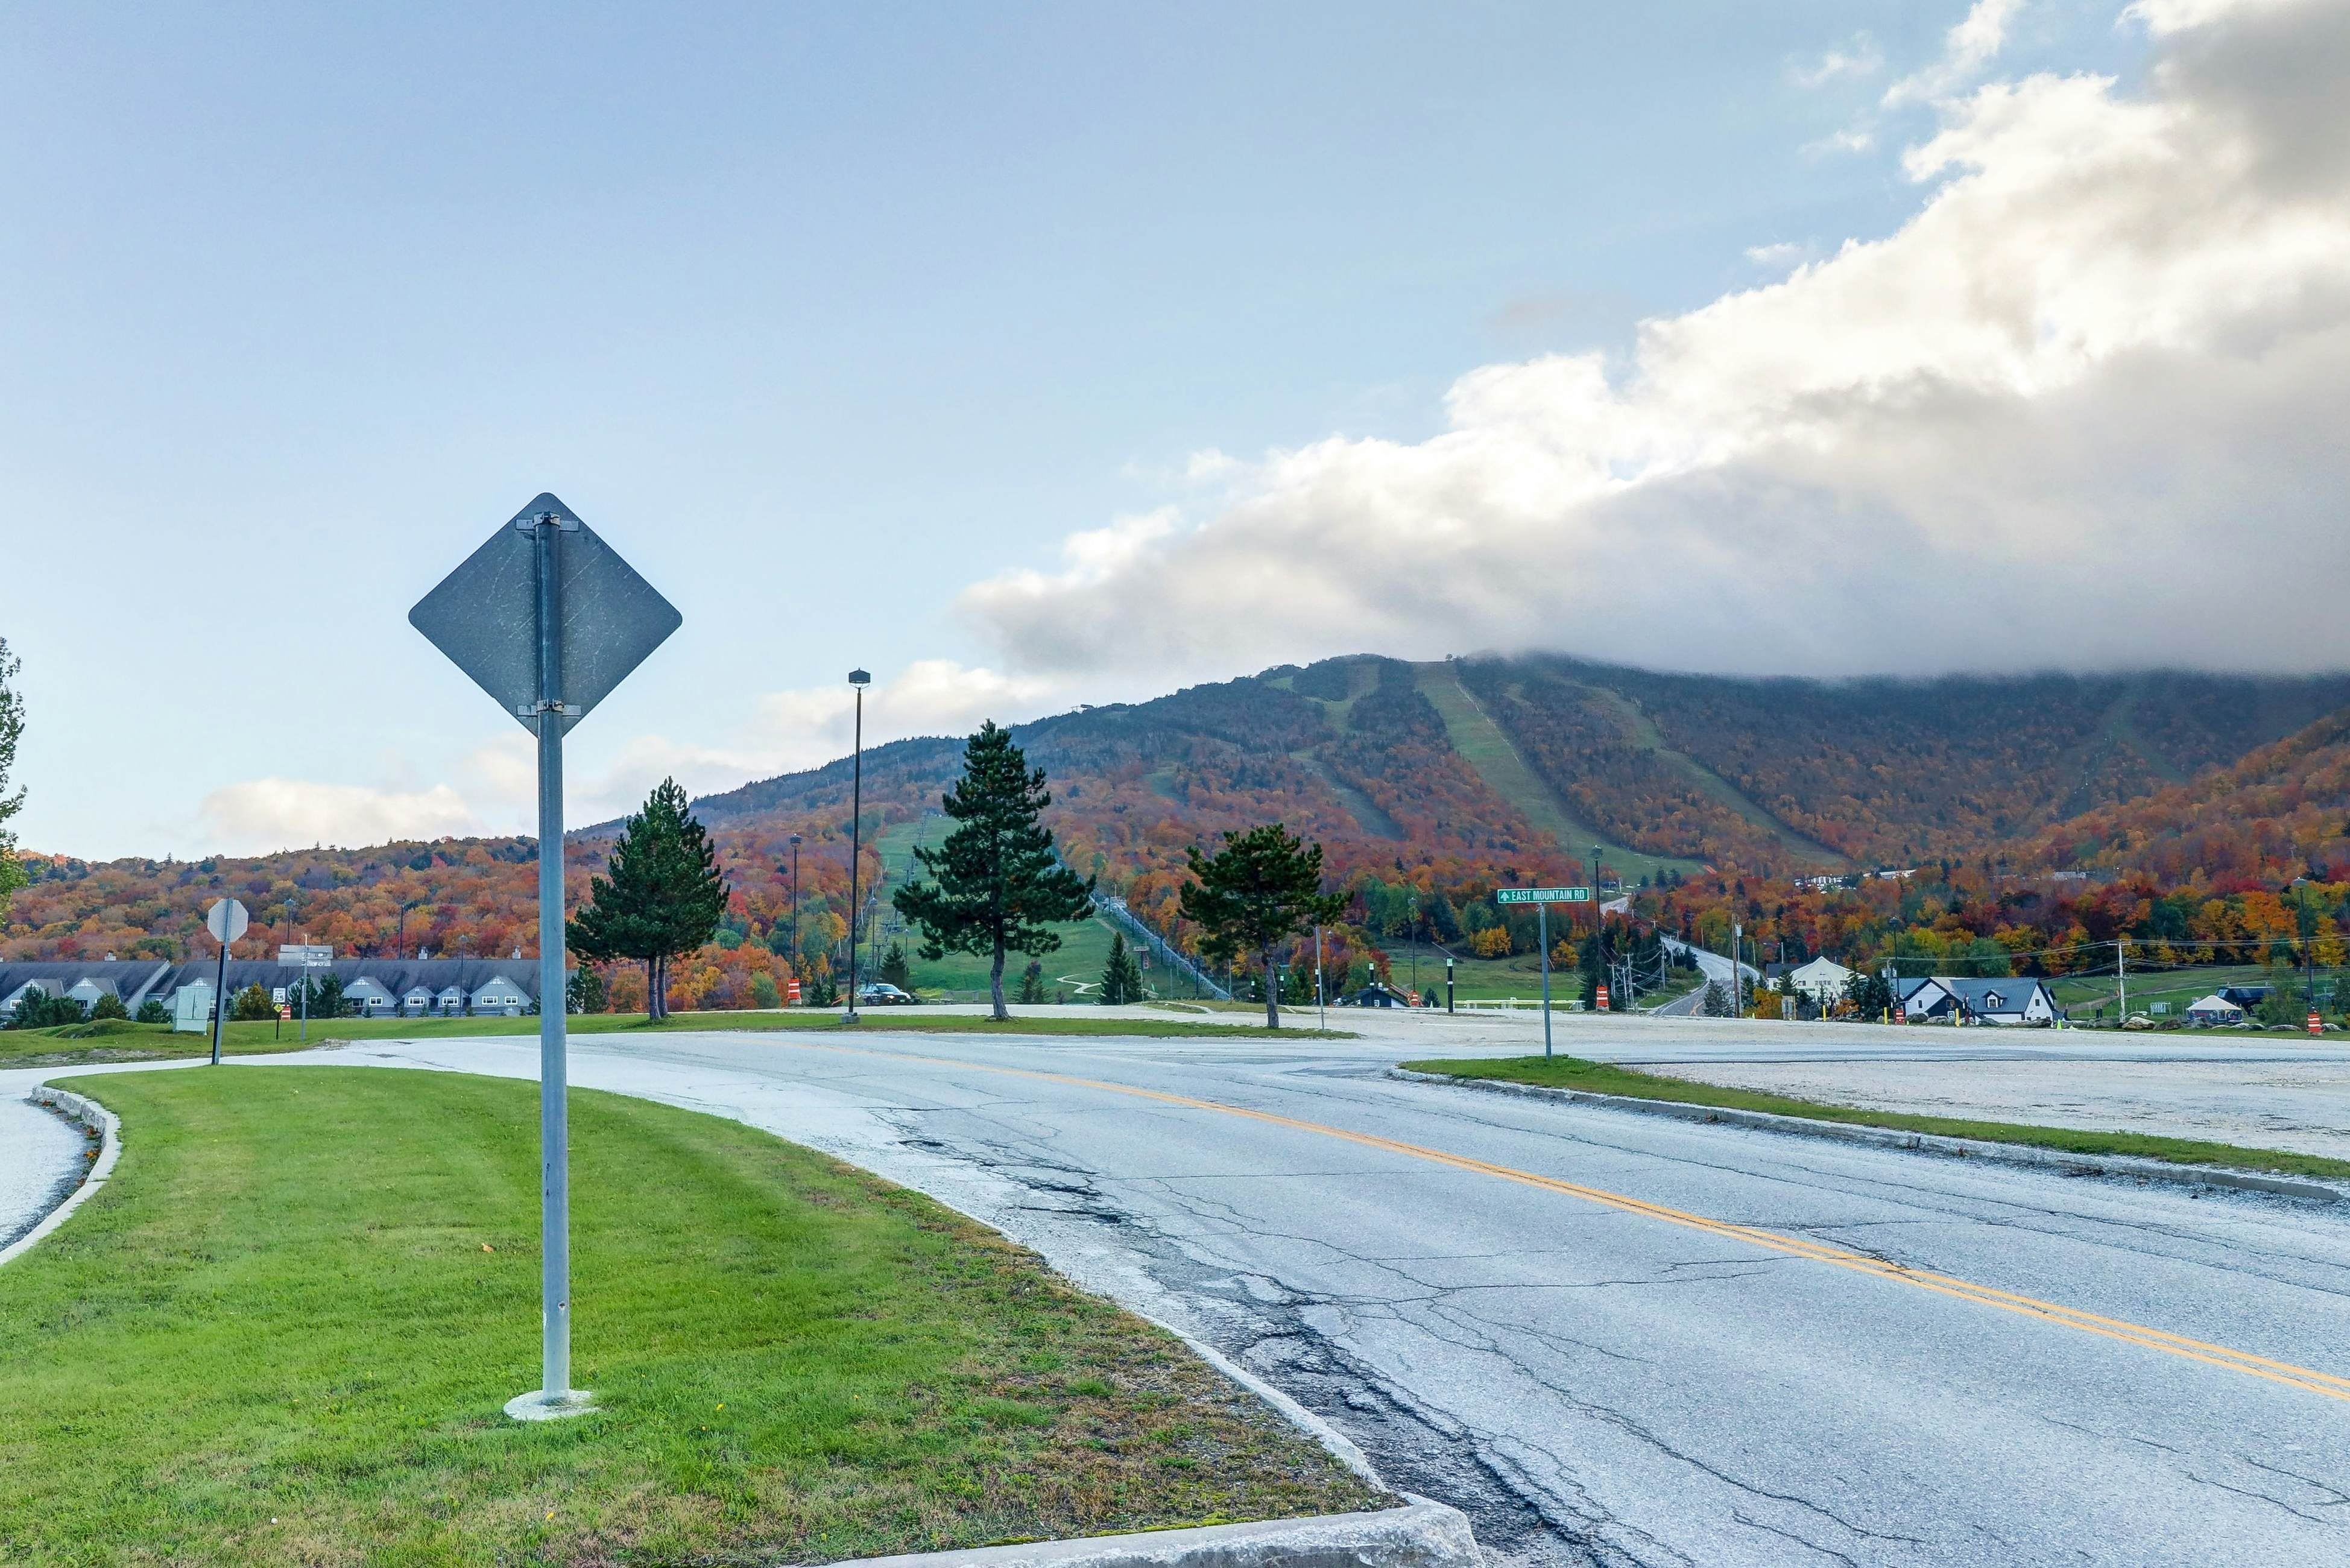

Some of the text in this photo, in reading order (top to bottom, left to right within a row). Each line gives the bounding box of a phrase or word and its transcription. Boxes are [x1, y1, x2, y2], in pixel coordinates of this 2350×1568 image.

[1512, 890, 1584, 901] EAST MOUNTAIN RD
